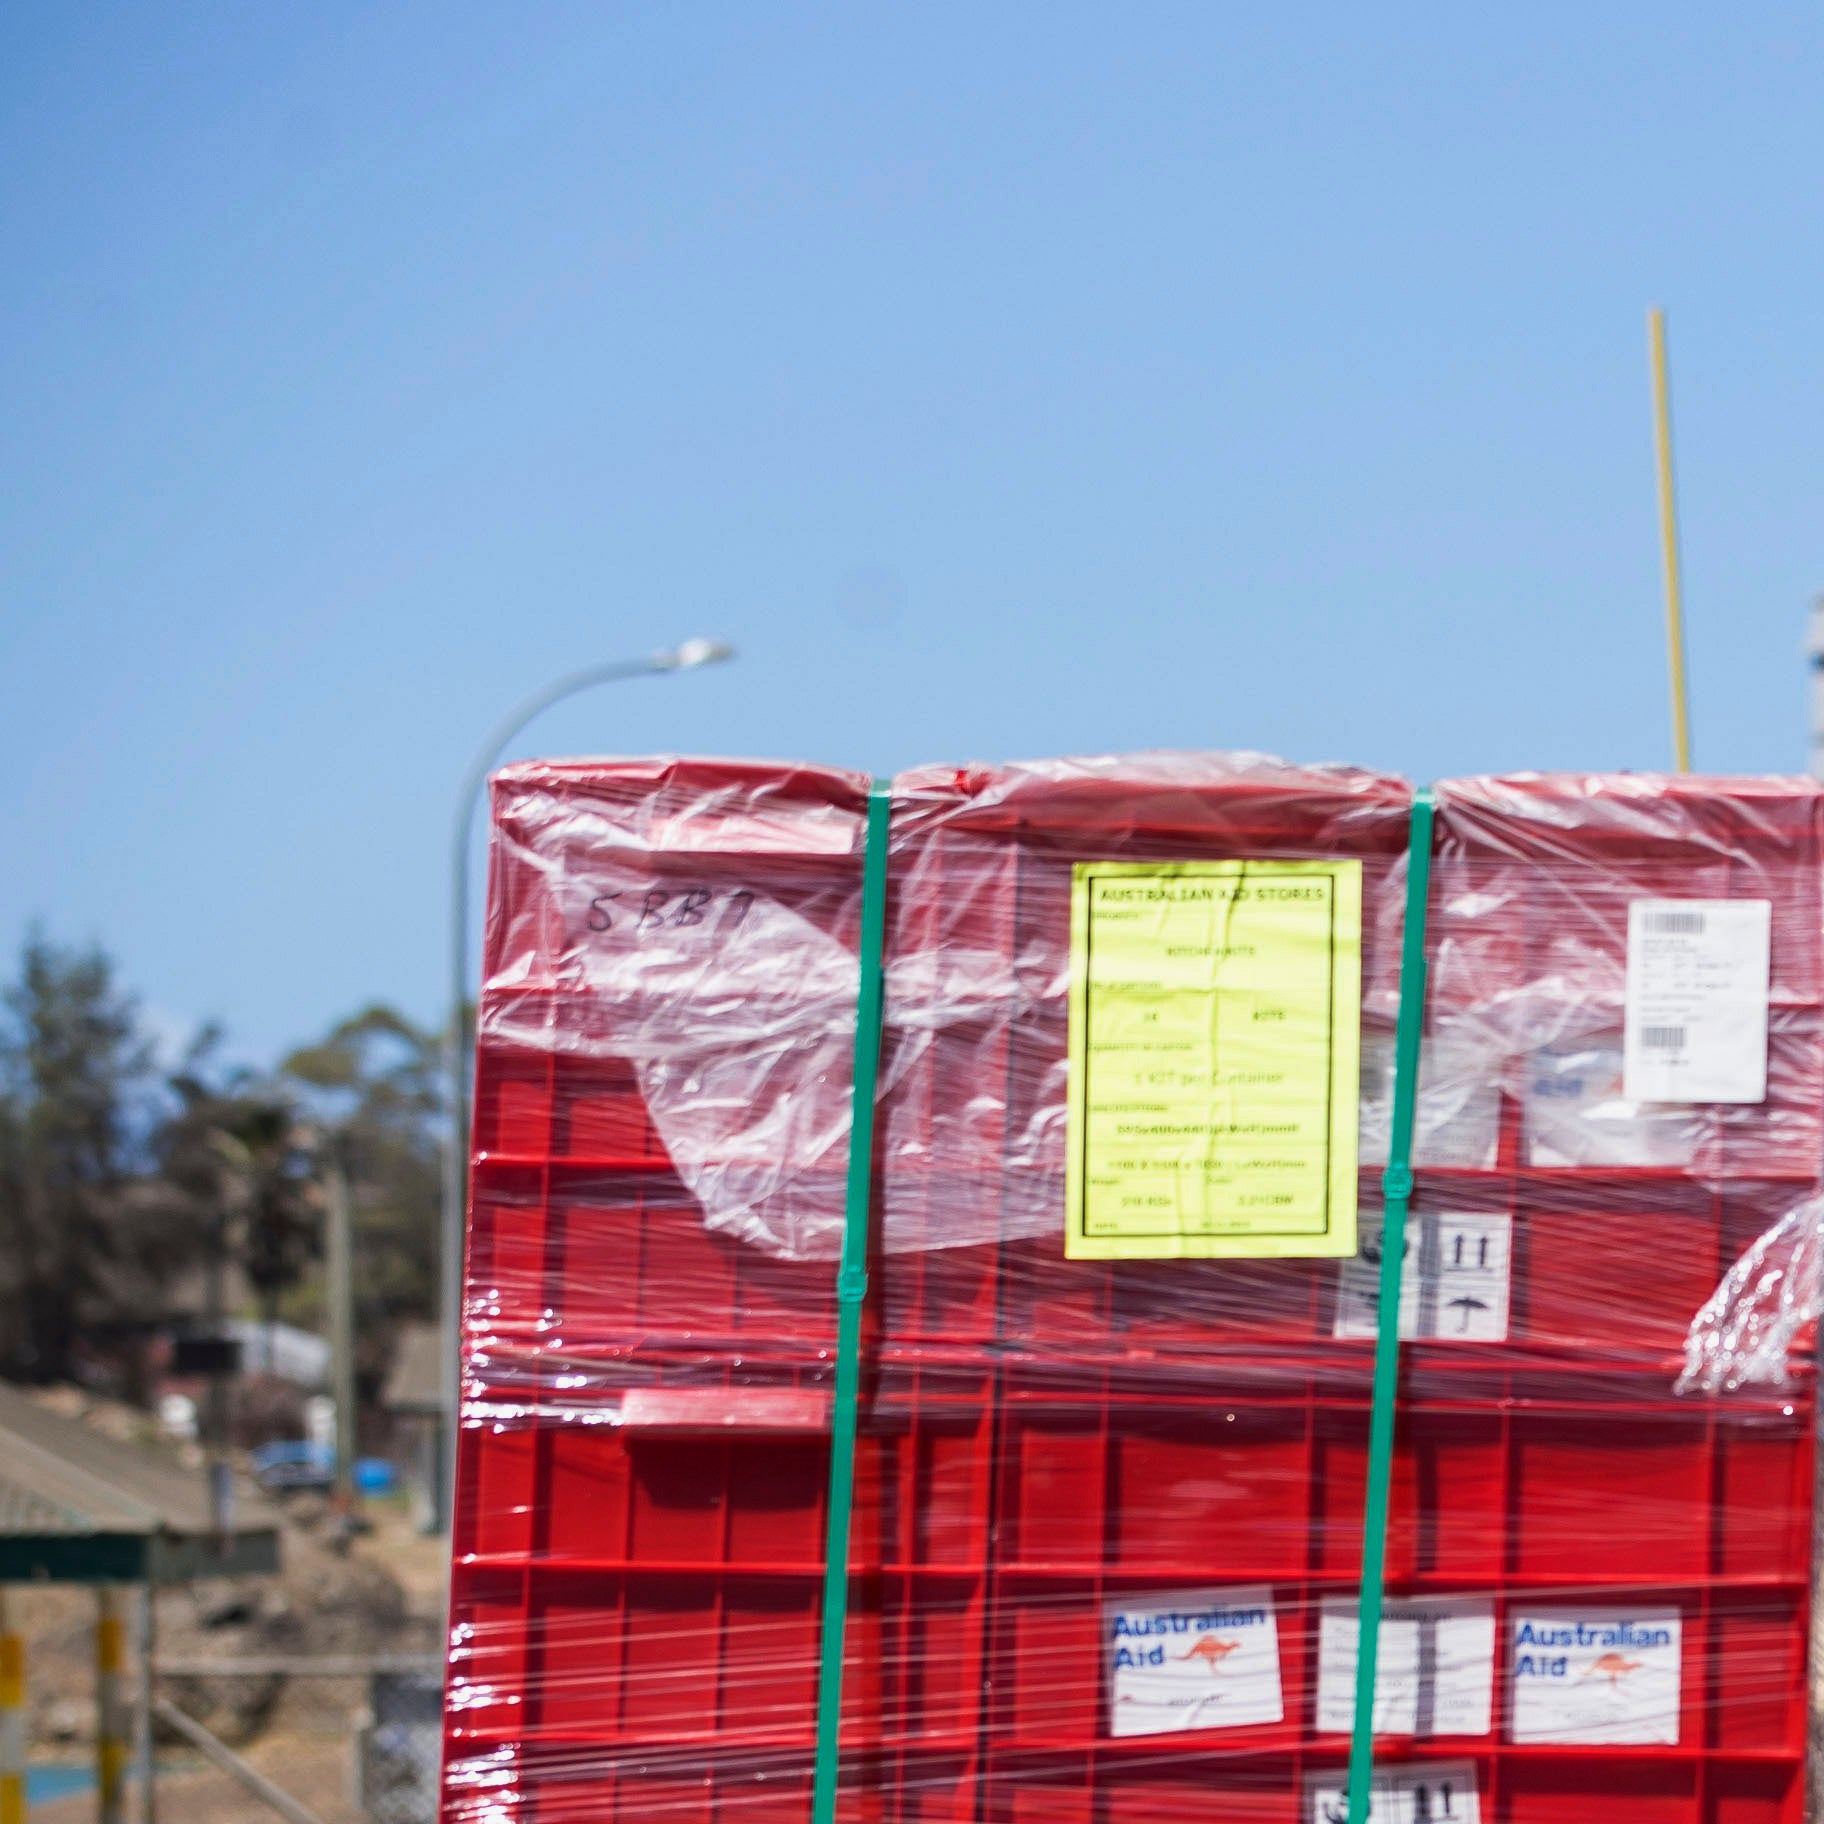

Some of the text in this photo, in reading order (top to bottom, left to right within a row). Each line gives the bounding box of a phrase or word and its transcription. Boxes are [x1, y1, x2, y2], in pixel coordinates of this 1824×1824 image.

[1101, 888, 1213, 902] AUSTRALIAN
[1256, 887, 1325, 901] STORES
[1114, 1603, 1266, 1637] Australian
[1516, 1621, 1670, 1647] Australian
[1114, 1645, 1165, 1669] Aid
[1516, 1654, 1568, 1677] Aid
